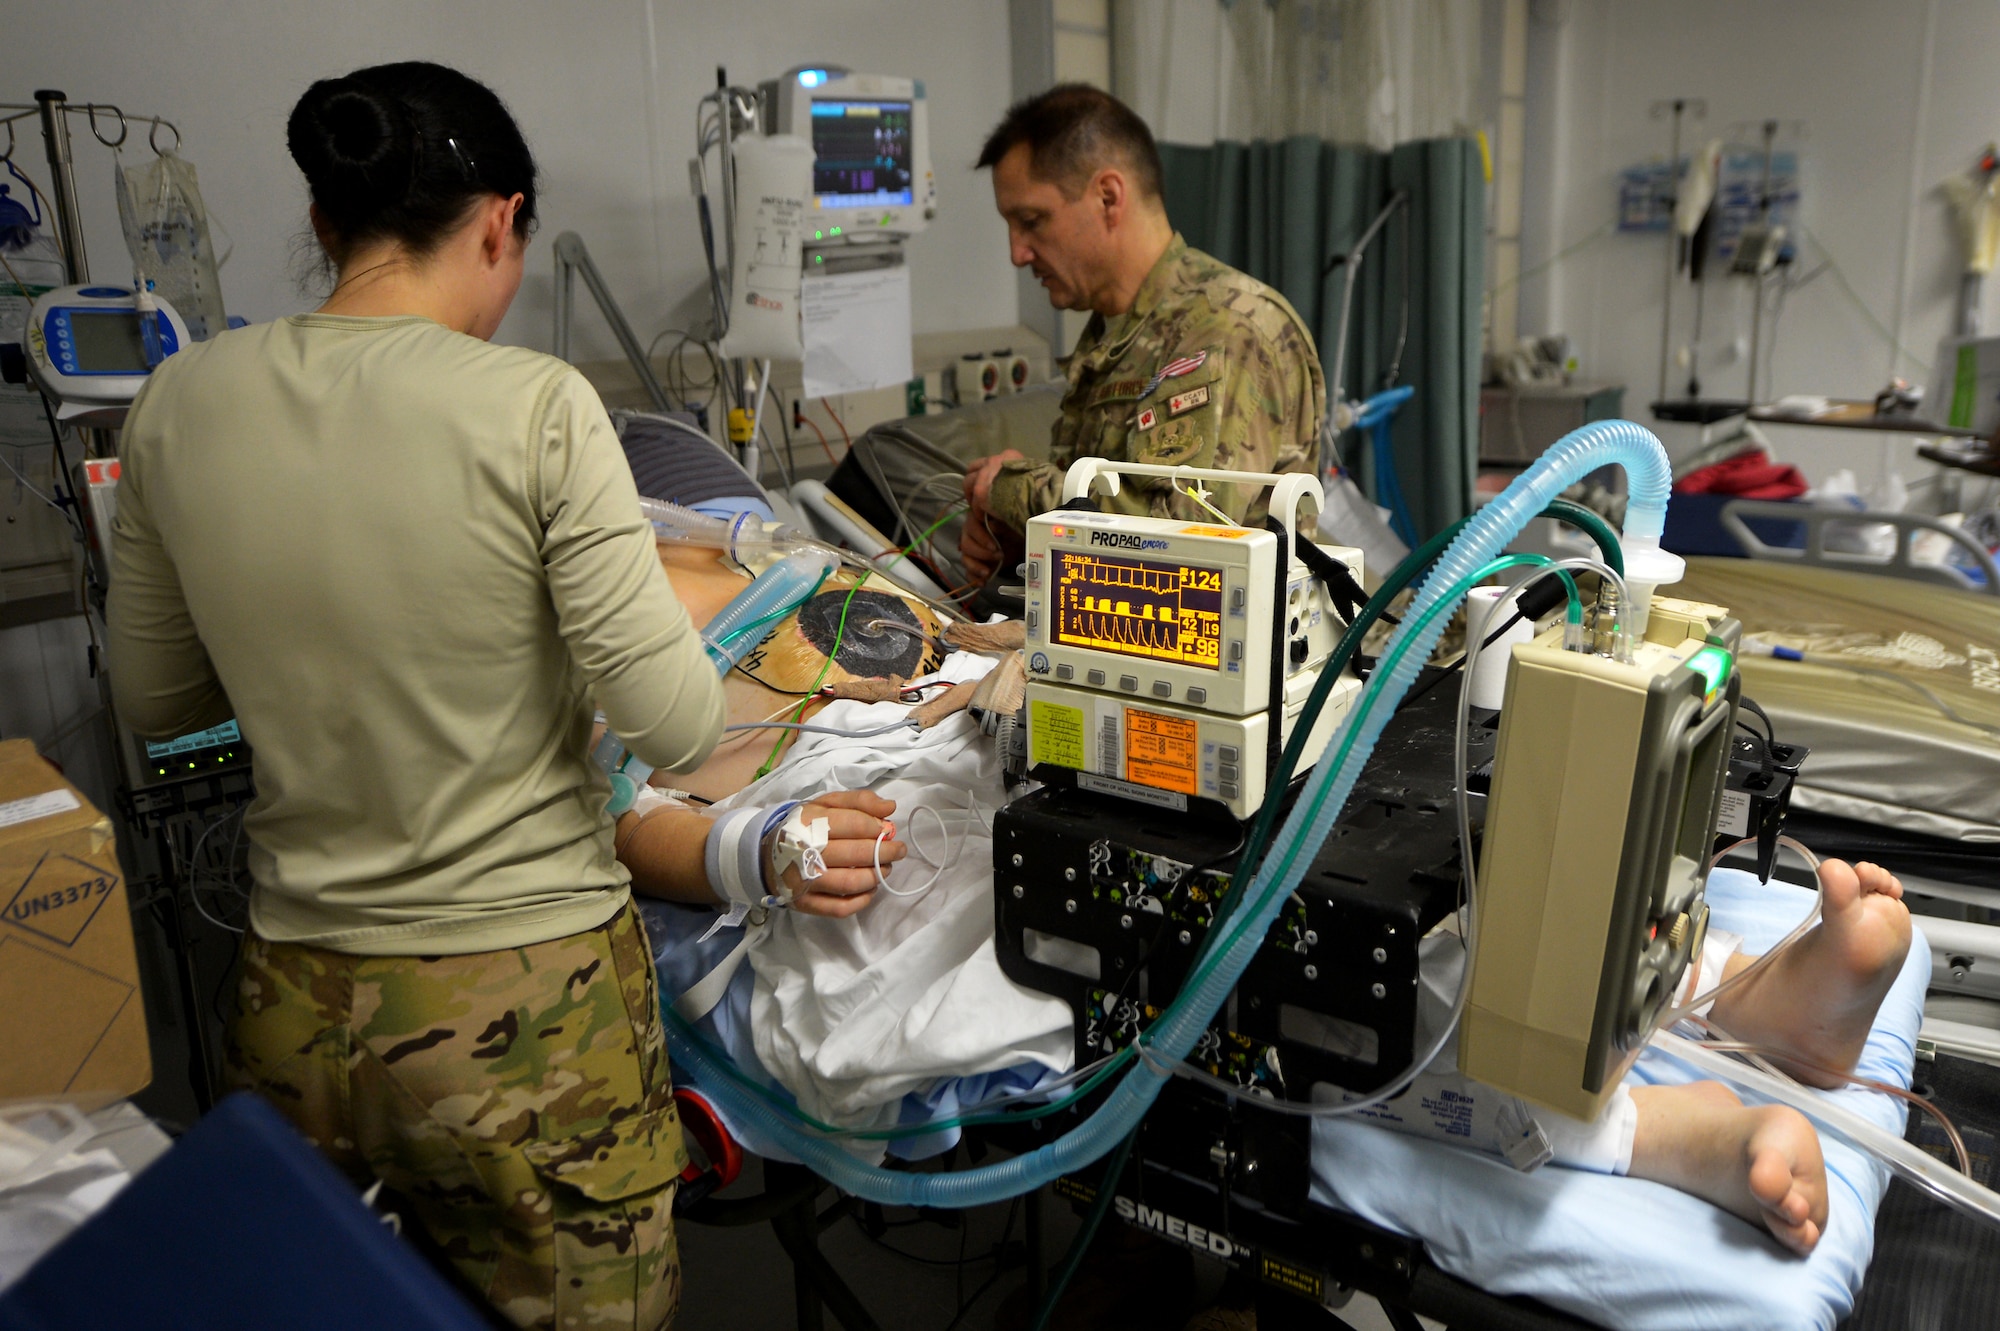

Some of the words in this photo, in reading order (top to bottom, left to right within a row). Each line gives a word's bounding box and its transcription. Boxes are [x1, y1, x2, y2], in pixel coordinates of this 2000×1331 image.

[1090, 531, 1142, 550] PROPAQ
[1189, 569, 1221, 590] 124
[1181, 617, 1198, 631] 42
[1205, 622, 1220, 636] 19
[1196, 638, 1220, 658] 98
[1093, 780, 1109, 789] FRONT
[1117, 785, 1130, 794] VITAL
[1146, 792, 1171, 802] MONITOR
[13, 877, 107, 920] UN3373
